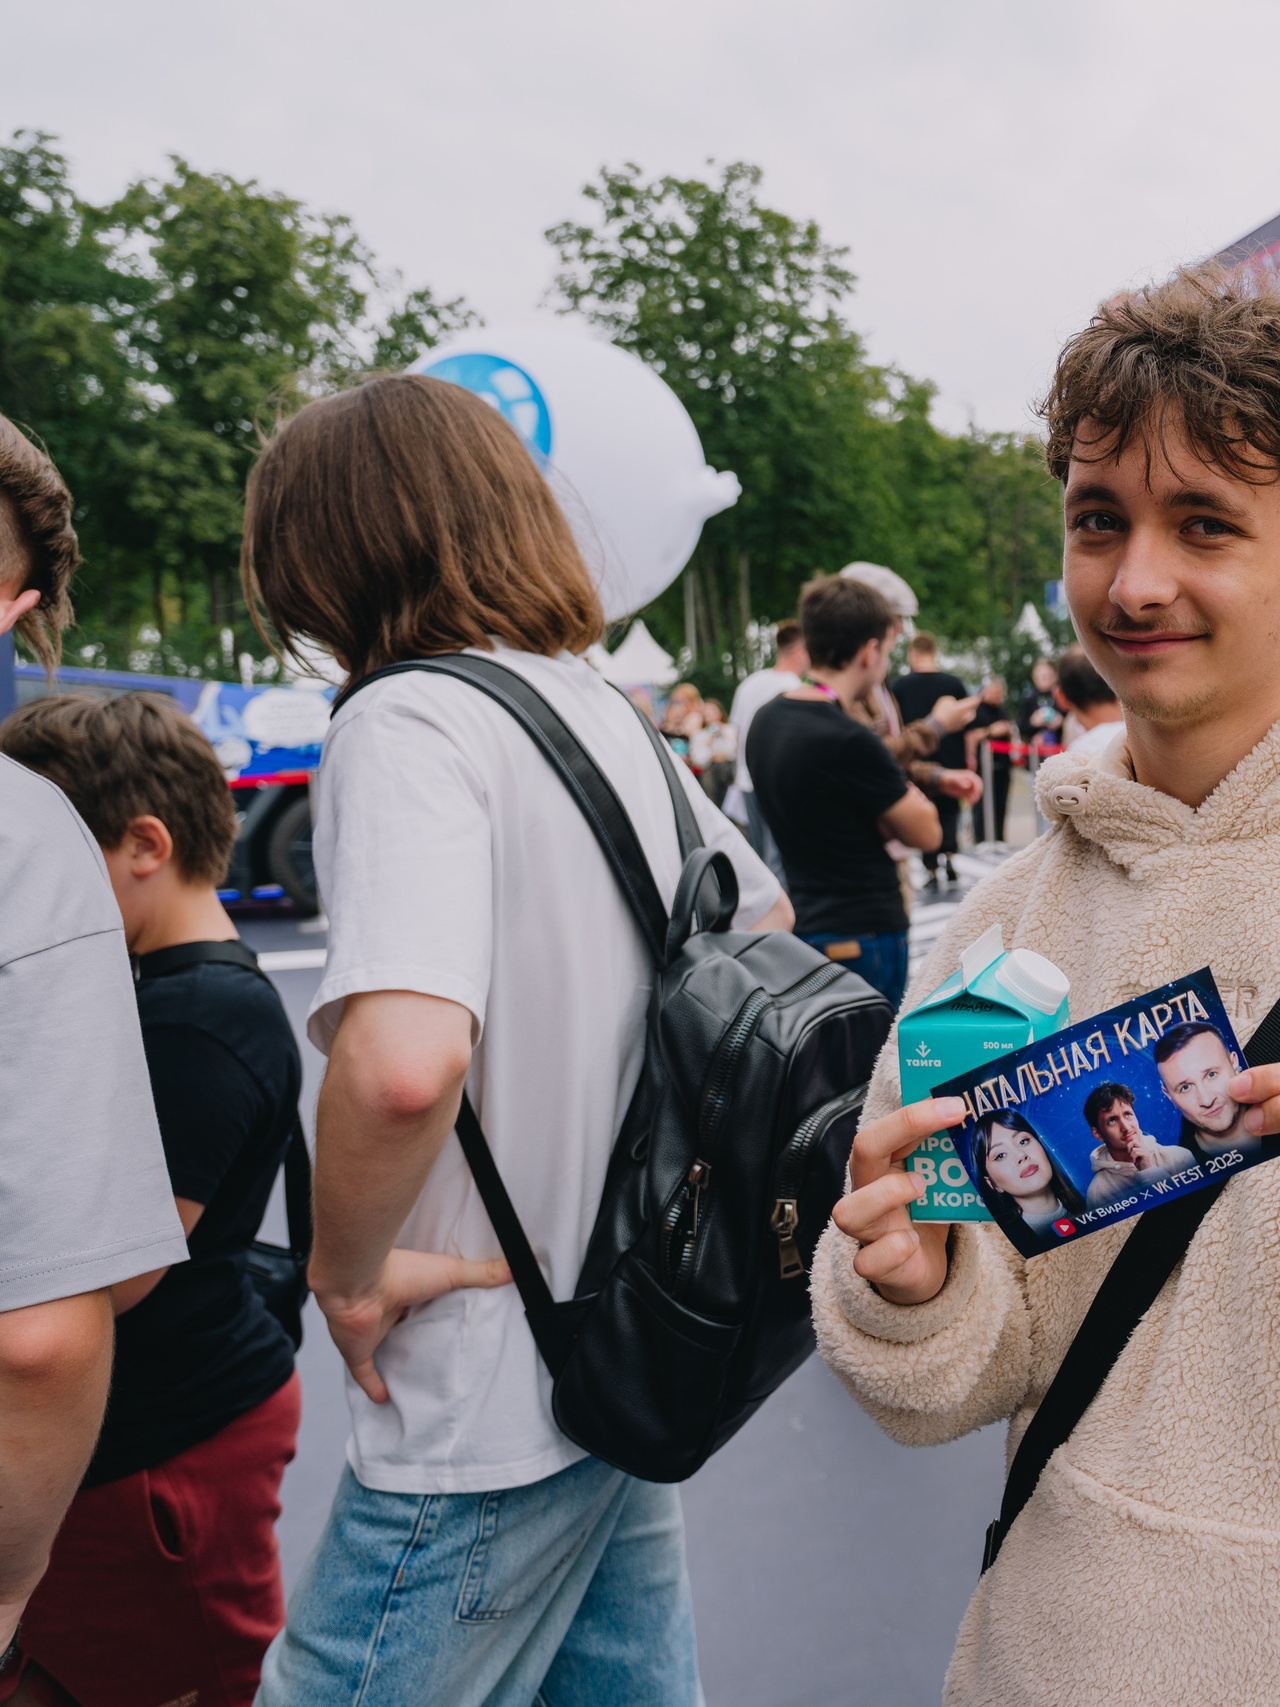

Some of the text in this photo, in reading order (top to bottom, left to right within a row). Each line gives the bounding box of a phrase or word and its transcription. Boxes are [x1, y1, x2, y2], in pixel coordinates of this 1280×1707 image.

[961, 1030, 1112, 1129] НАТАЛЬНАЯ
[1113, 990, 1210, 1056] КАРТА
[983, 1041, 999, 1049] 500
[1075, 1208, 1098, 1225] VK
[1096, 1196, 1139, 1217] Видео
[1152, 1180, 1173, 1195] VK
[1171, 1164, 1205, 1188] FEST
[1205, 1149, 1244, 1174] 2025
